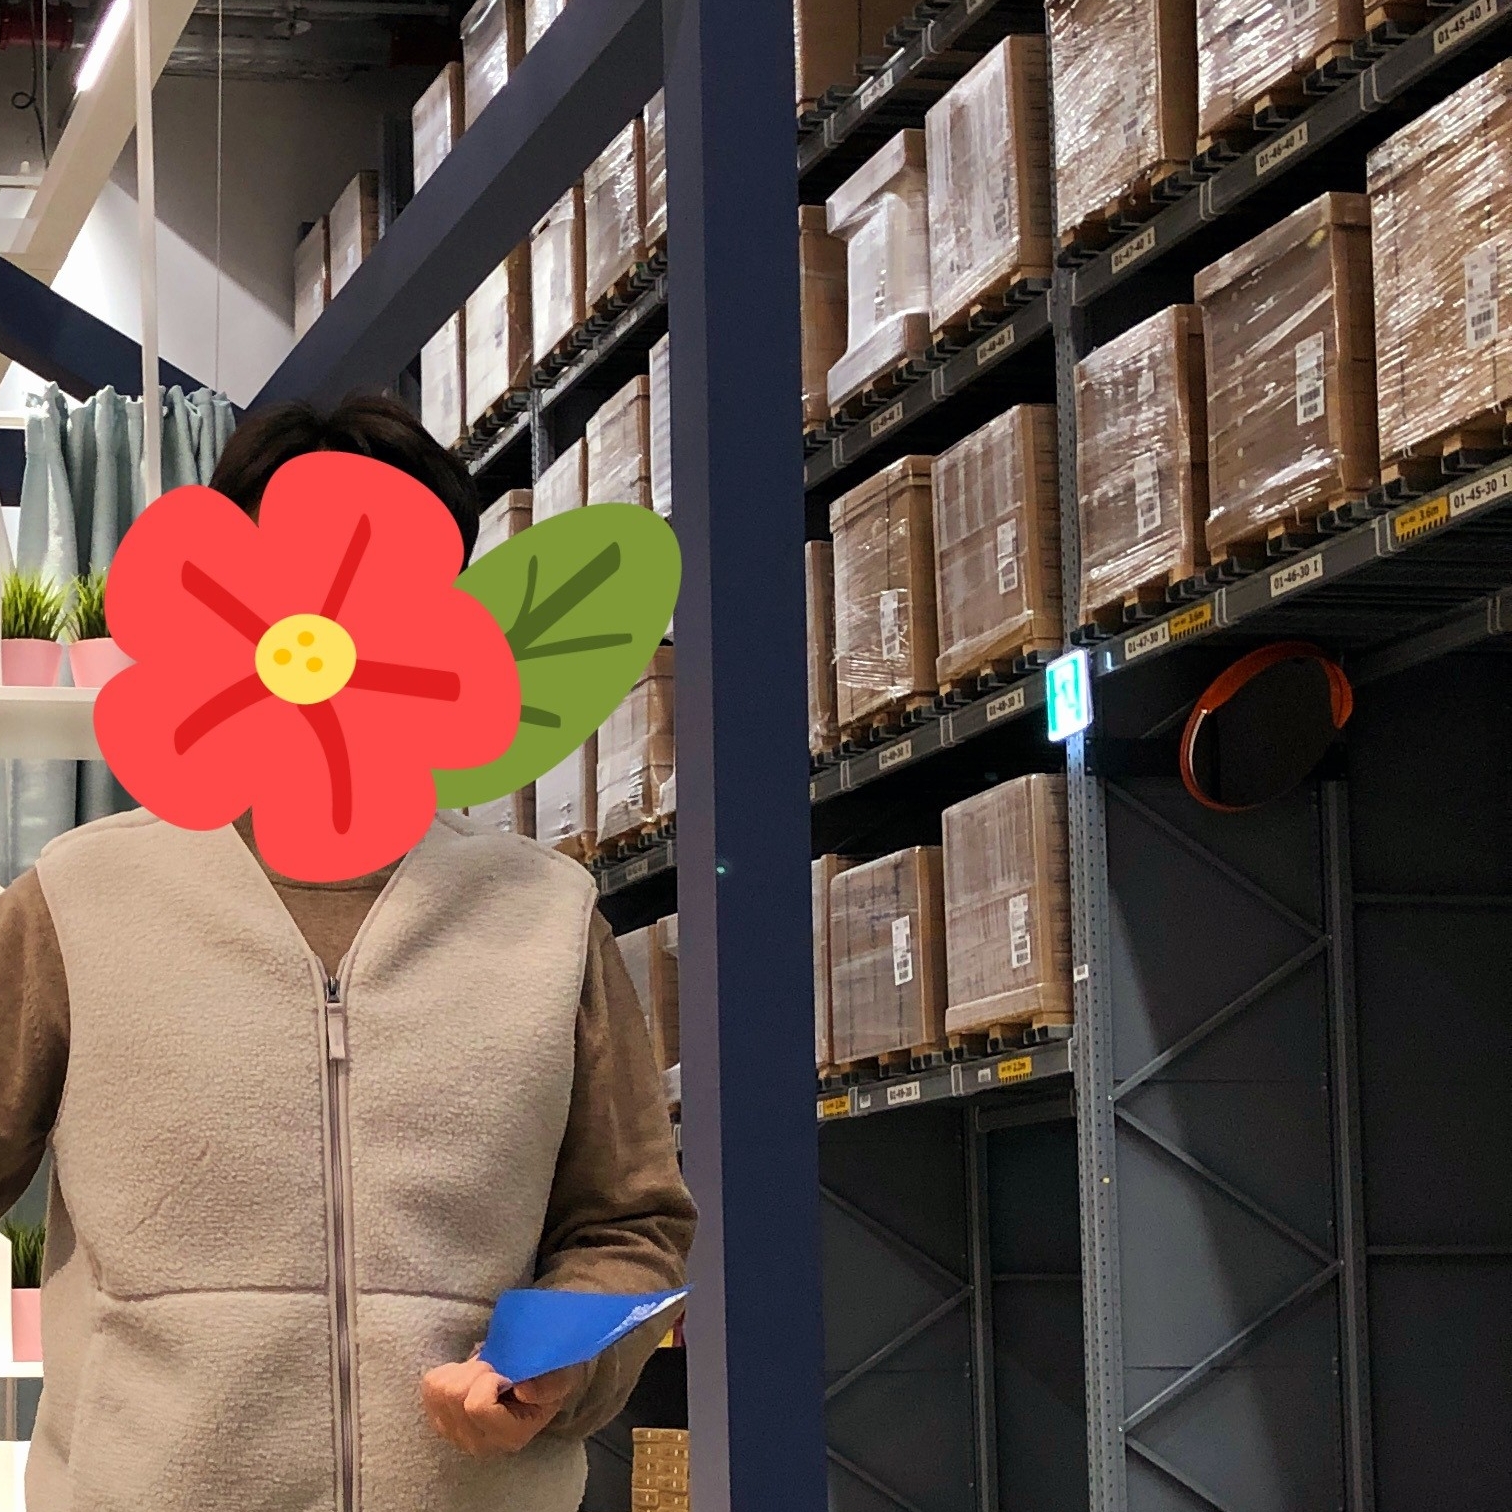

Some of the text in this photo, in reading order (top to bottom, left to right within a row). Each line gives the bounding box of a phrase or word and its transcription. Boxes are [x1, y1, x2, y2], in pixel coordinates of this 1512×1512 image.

[1437, 5, 1481, 44] 01-45-40
[1258, 134, 1294, 168] 01-46-40
[1454, 478, 1497, 509] 01-45-30
[1274, 563, 1310, 590] 01-46-30
[1127, 630, 1159, 654] 01-47-30
